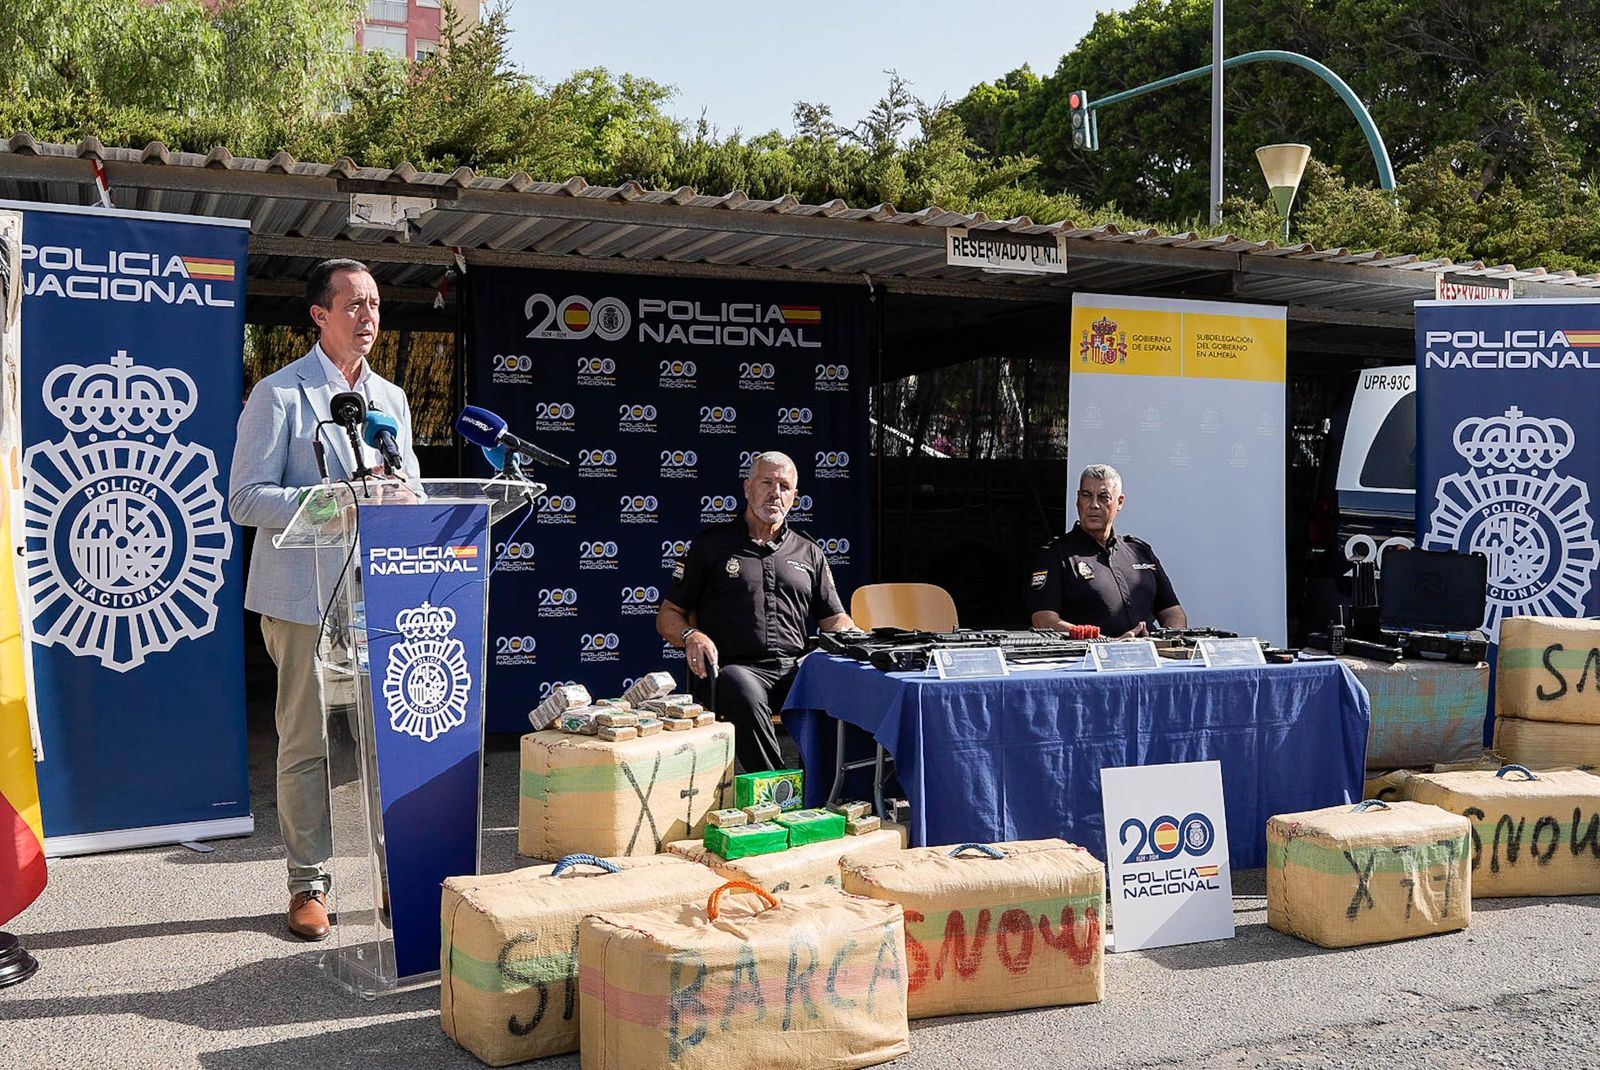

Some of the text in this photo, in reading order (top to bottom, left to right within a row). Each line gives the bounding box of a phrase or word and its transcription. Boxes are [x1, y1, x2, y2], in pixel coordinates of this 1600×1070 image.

[953, 236, 1027, 261] RESERVADO
[524, 293, 632, 341] 200
[638, 323, 822, 348] NACIONAL
[1132, 335, 1172, 343] GOBIERNO
[1196, 334, 1253, 343] SUBDELEGACIÓN
[1144, 344, 1172, 352] ESPAÑA
[1208, 351, 1237, 359] ALMERÍA
[1211, 343, 1248, 352] GOBIERNO
[1425, 351, 1600, 369] NACIONAL
[1364, 375, 1411, 390] UPR-93C
[84, 479, 158, 501] POLICÍA
[1481, 502, 1539, 521] POLICÍA
[370, 559, 478, 576] NACIONAL
[73, 578, 170, 607] NACIONAL
[1489, 580, 1547, 600] CIONAL
[496, 636, 536, 653] 200
[581, 633, 619, 650] 200
[409, 700, 447, 714] NACIONAL
[1120, 812, 1214, 864] 200
[1124, 879, 1220, 899] NACIONAL
[669, 923, 906, 1061] BARCA
